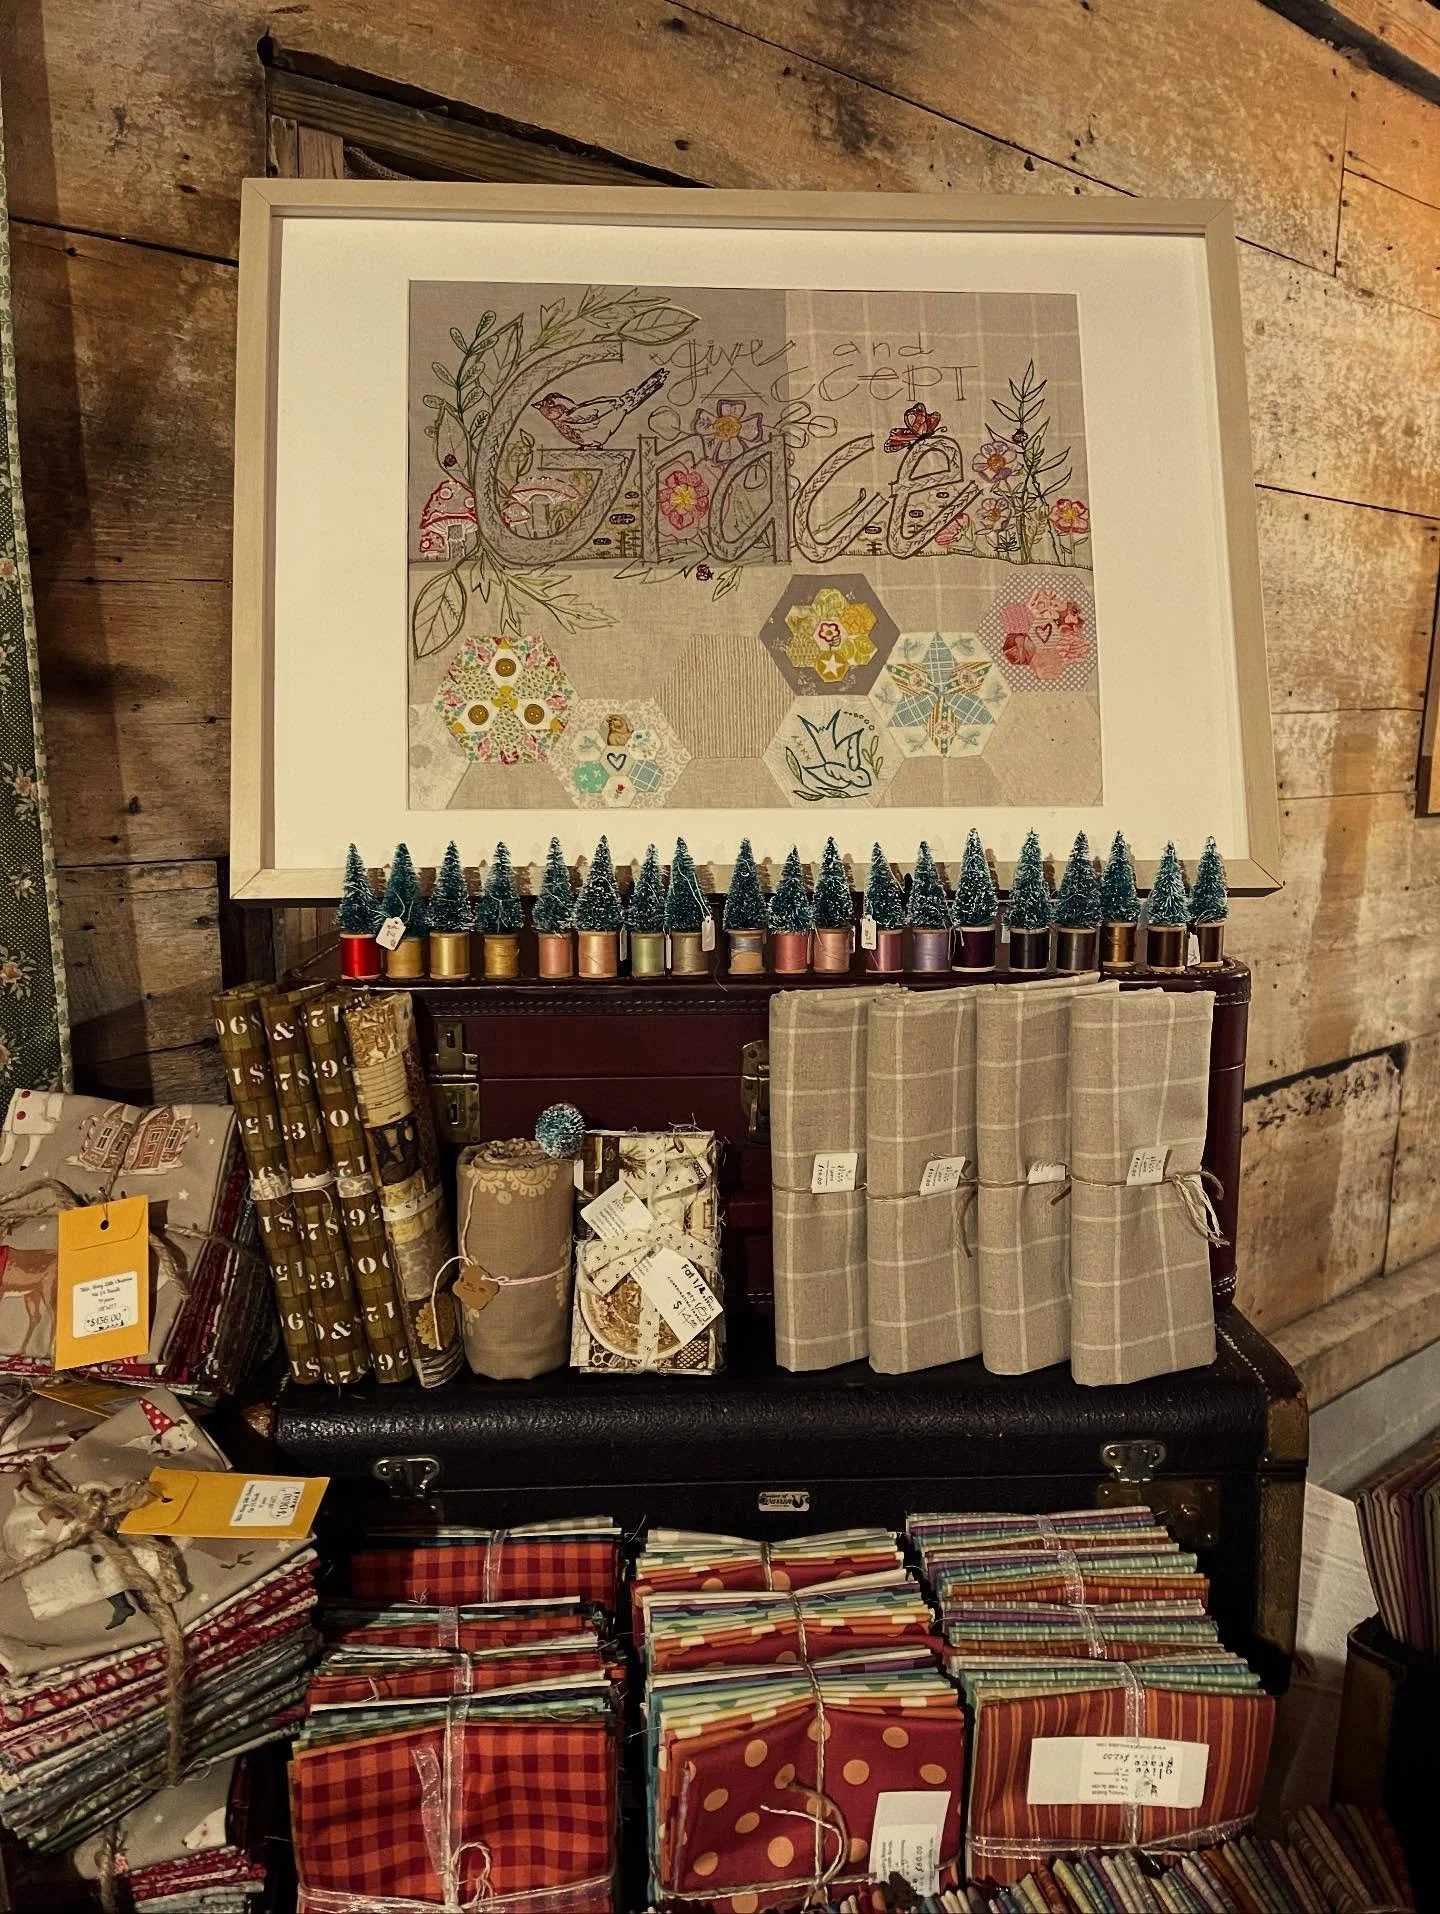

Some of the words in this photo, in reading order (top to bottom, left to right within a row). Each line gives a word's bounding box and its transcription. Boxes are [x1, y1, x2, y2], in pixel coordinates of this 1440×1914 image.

[650, 339, 796, 406] give
[833, 332, 935, 357] and
[475, 339, 984, 564] Grace
